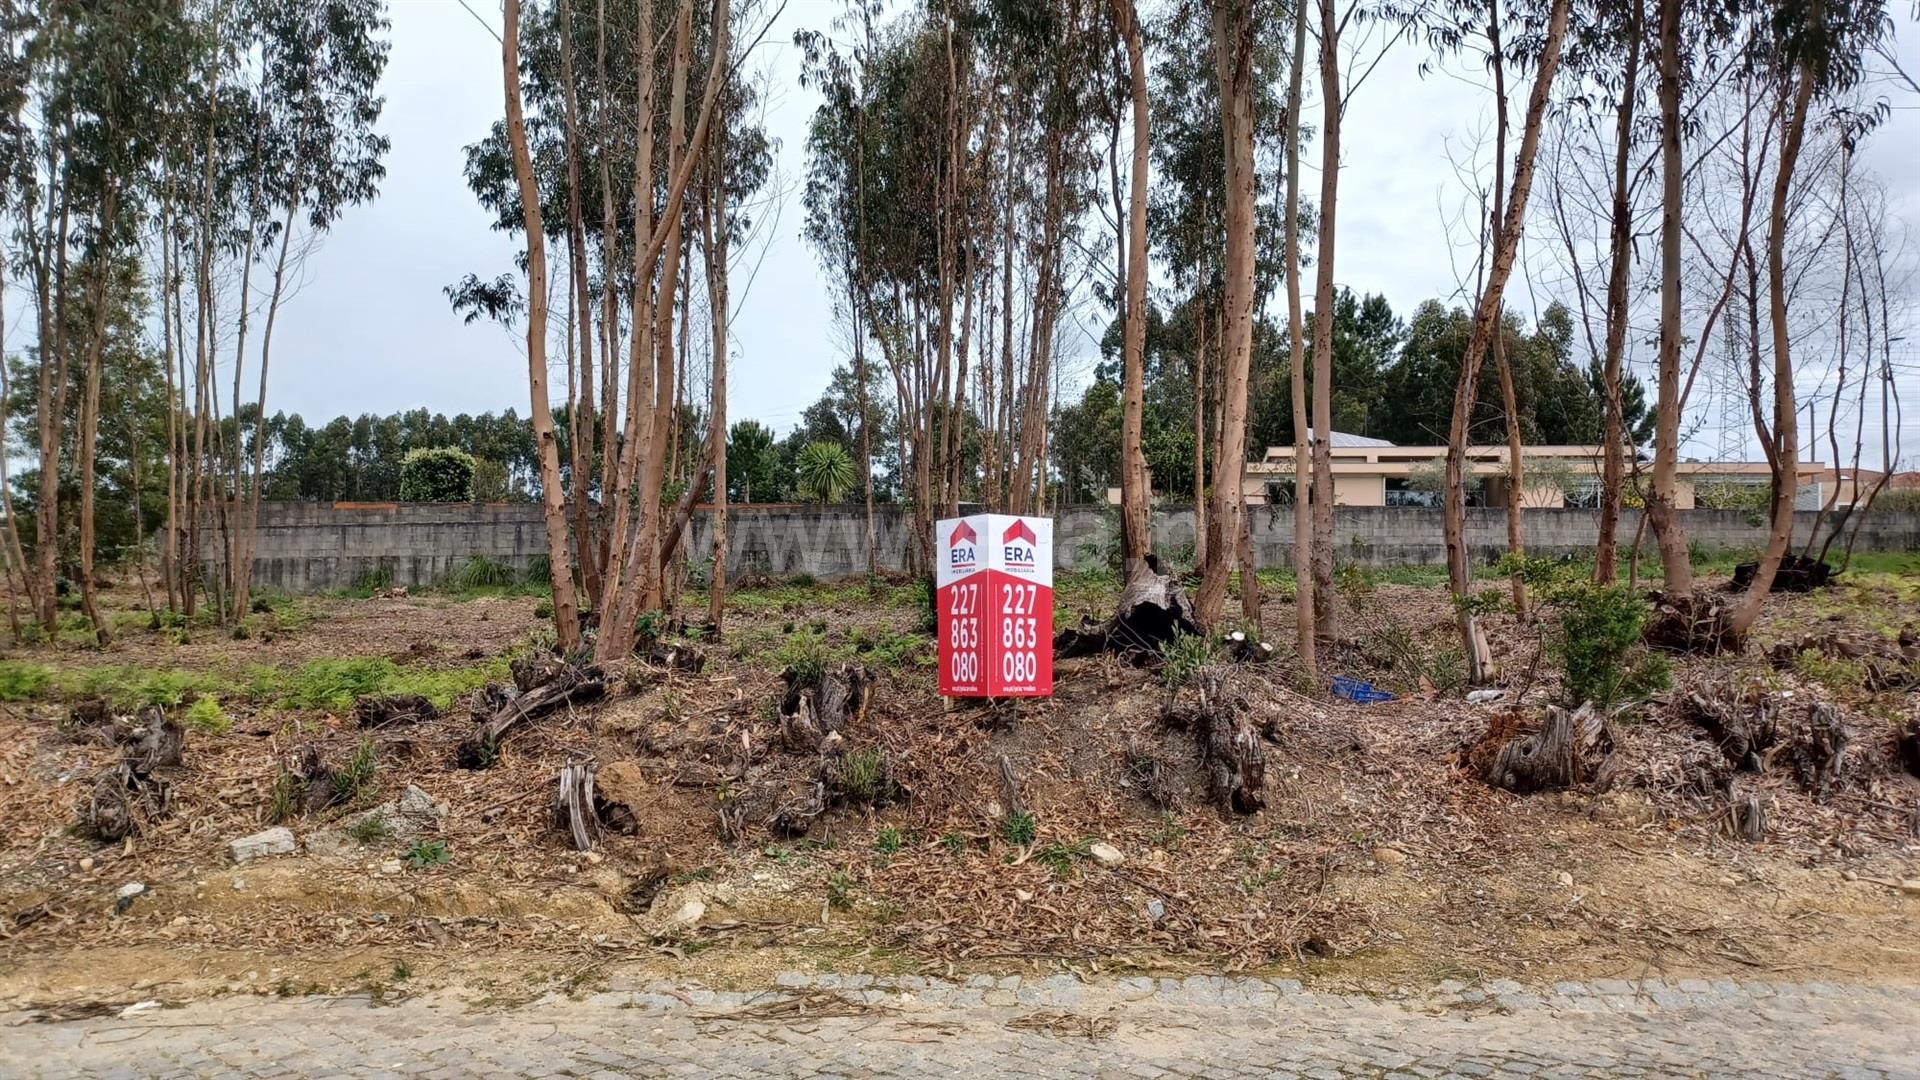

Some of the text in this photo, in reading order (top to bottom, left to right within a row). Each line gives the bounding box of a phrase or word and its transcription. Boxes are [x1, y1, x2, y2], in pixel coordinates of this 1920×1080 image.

[951, 547, 976, 563] ERA
[1004, 546, 1034, 562] ERA
[951, 584, 978, 615] 227
[1003, 584, 1037, 615] 227
[951, 618, 978, 649] 863
[1003, 618, 1037, 649] 863
[951, 651, 978, 682] 080
[1003, 651, 1037, 682] 080
